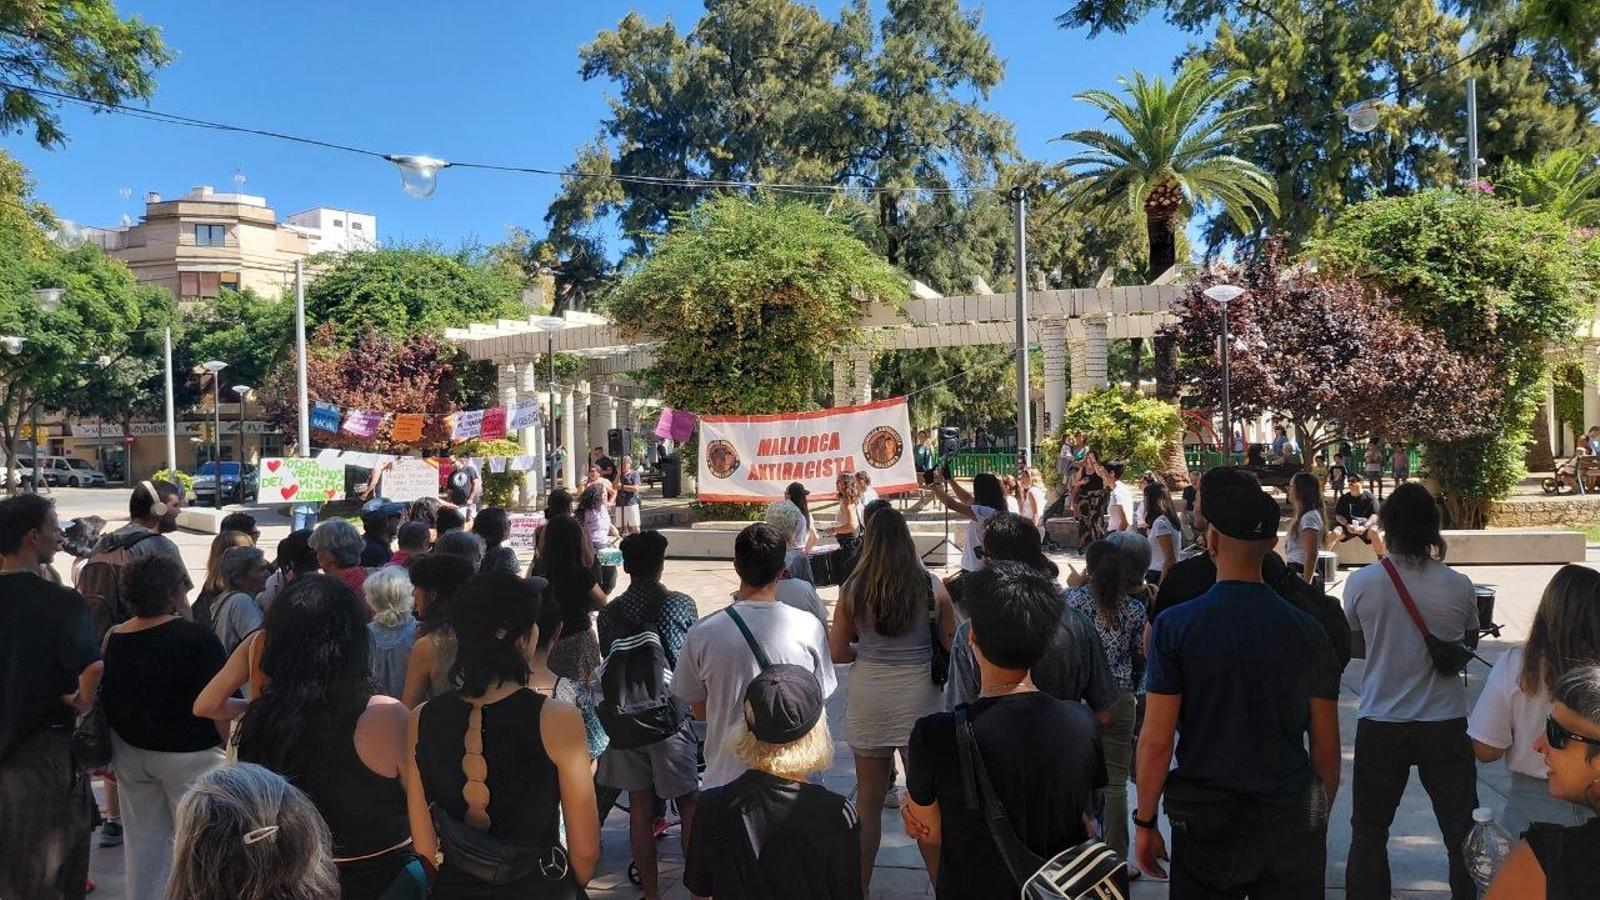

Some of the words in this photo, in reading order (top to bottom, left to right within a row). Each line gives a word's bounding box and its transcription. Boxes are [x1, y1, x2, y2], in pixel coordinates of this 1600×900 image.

[756, 432, 841, 457] MALLORCA
[283, 457, 318, 470] TODOS
[747, 456, 856, 481] ANTIRACISTA
